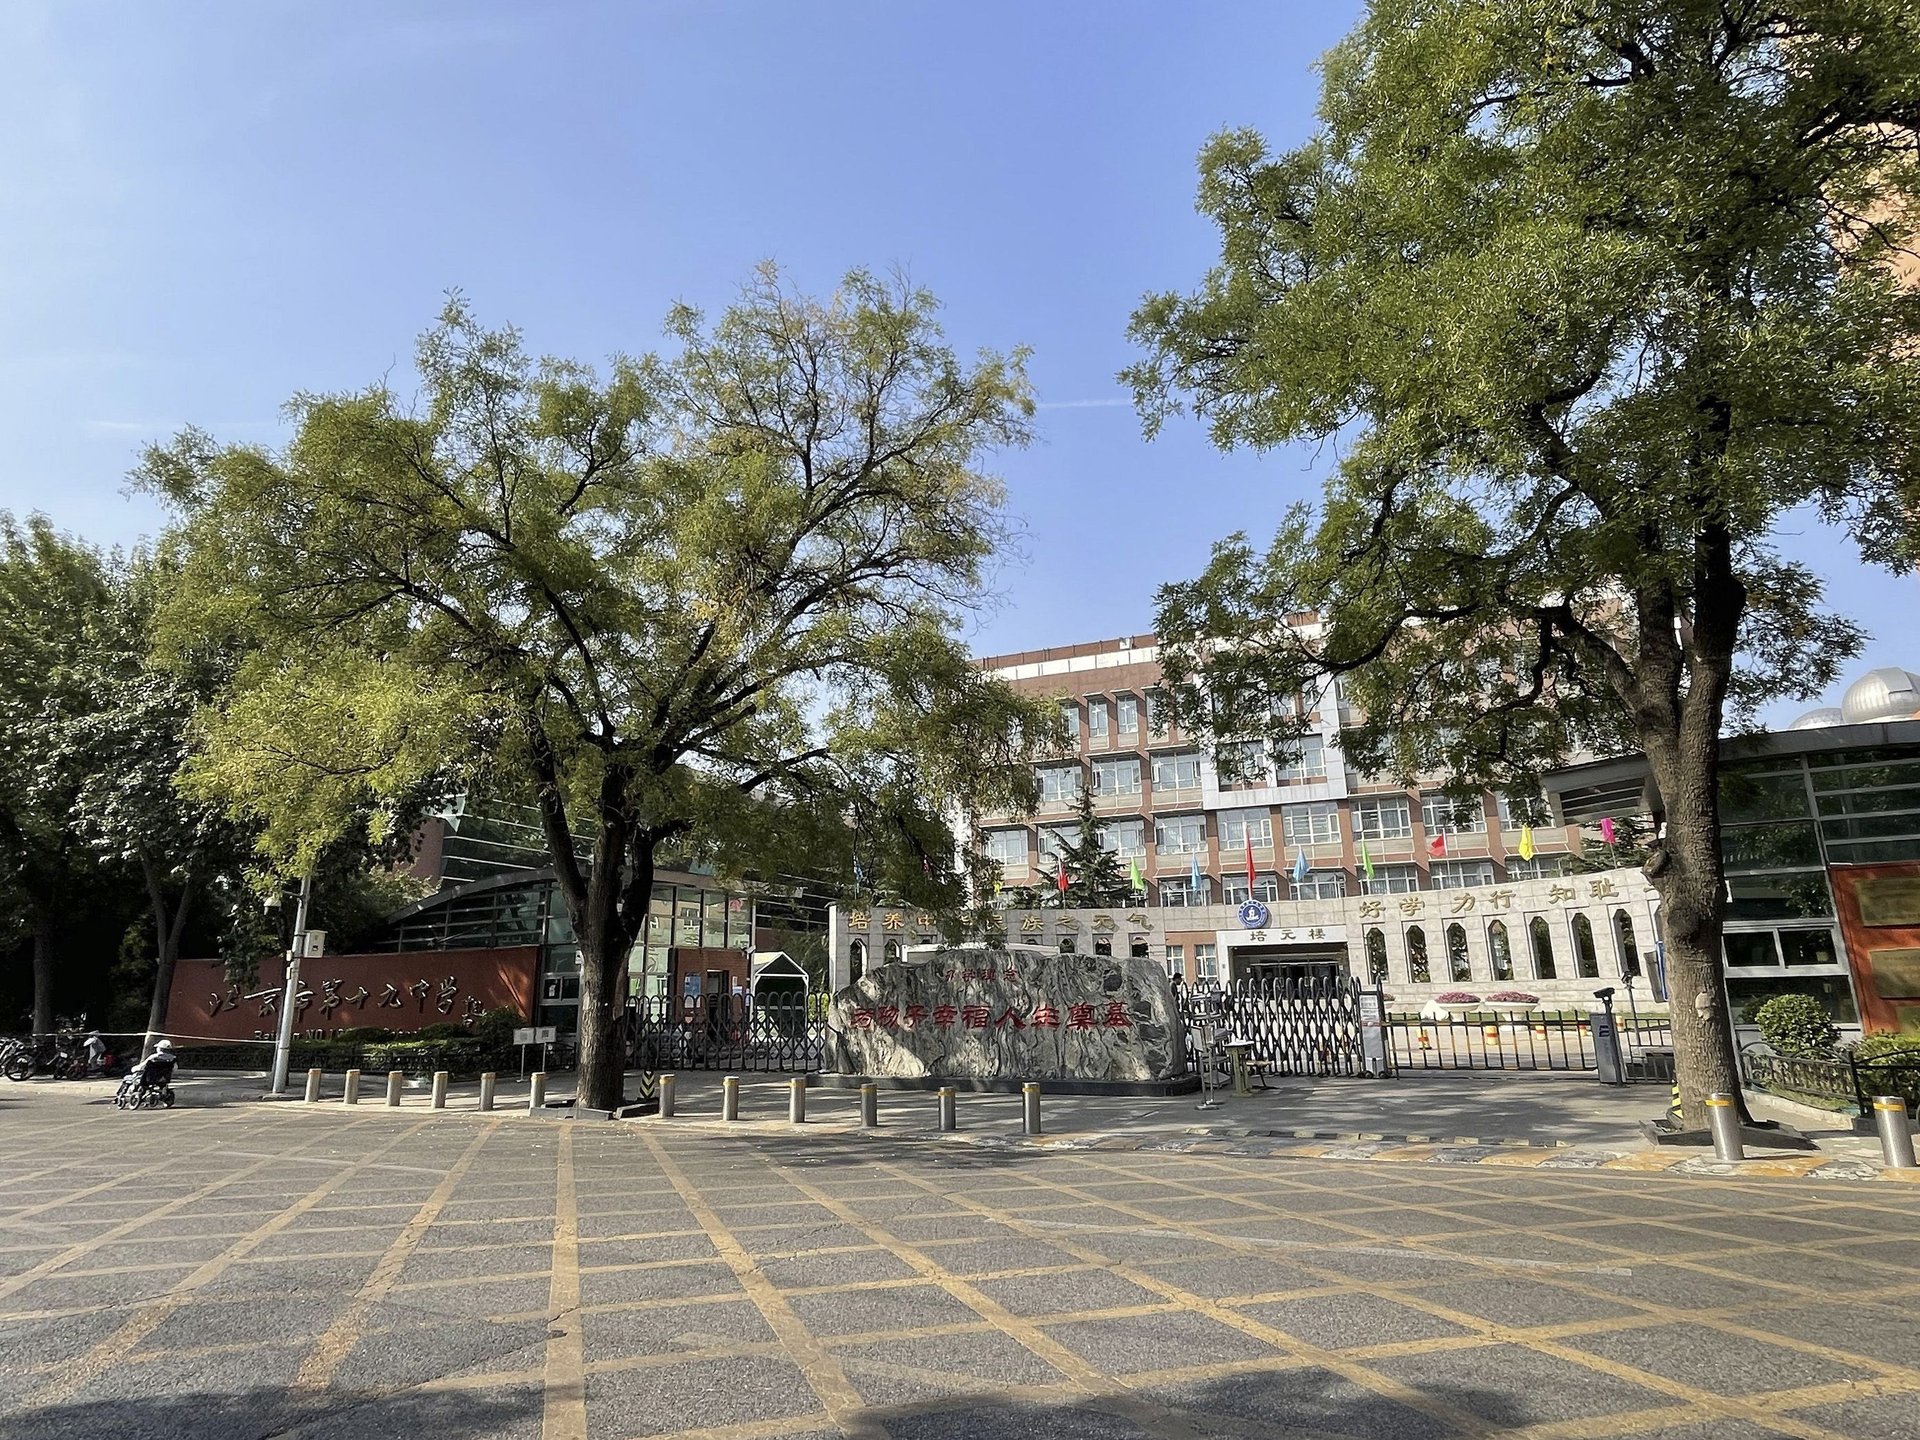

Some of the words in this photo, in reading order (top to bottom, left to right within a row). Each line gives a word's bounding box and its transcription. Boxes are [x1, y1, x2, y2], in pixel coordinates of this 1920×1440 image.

[1359, 878, 1656, 918] 好学力行知耻
